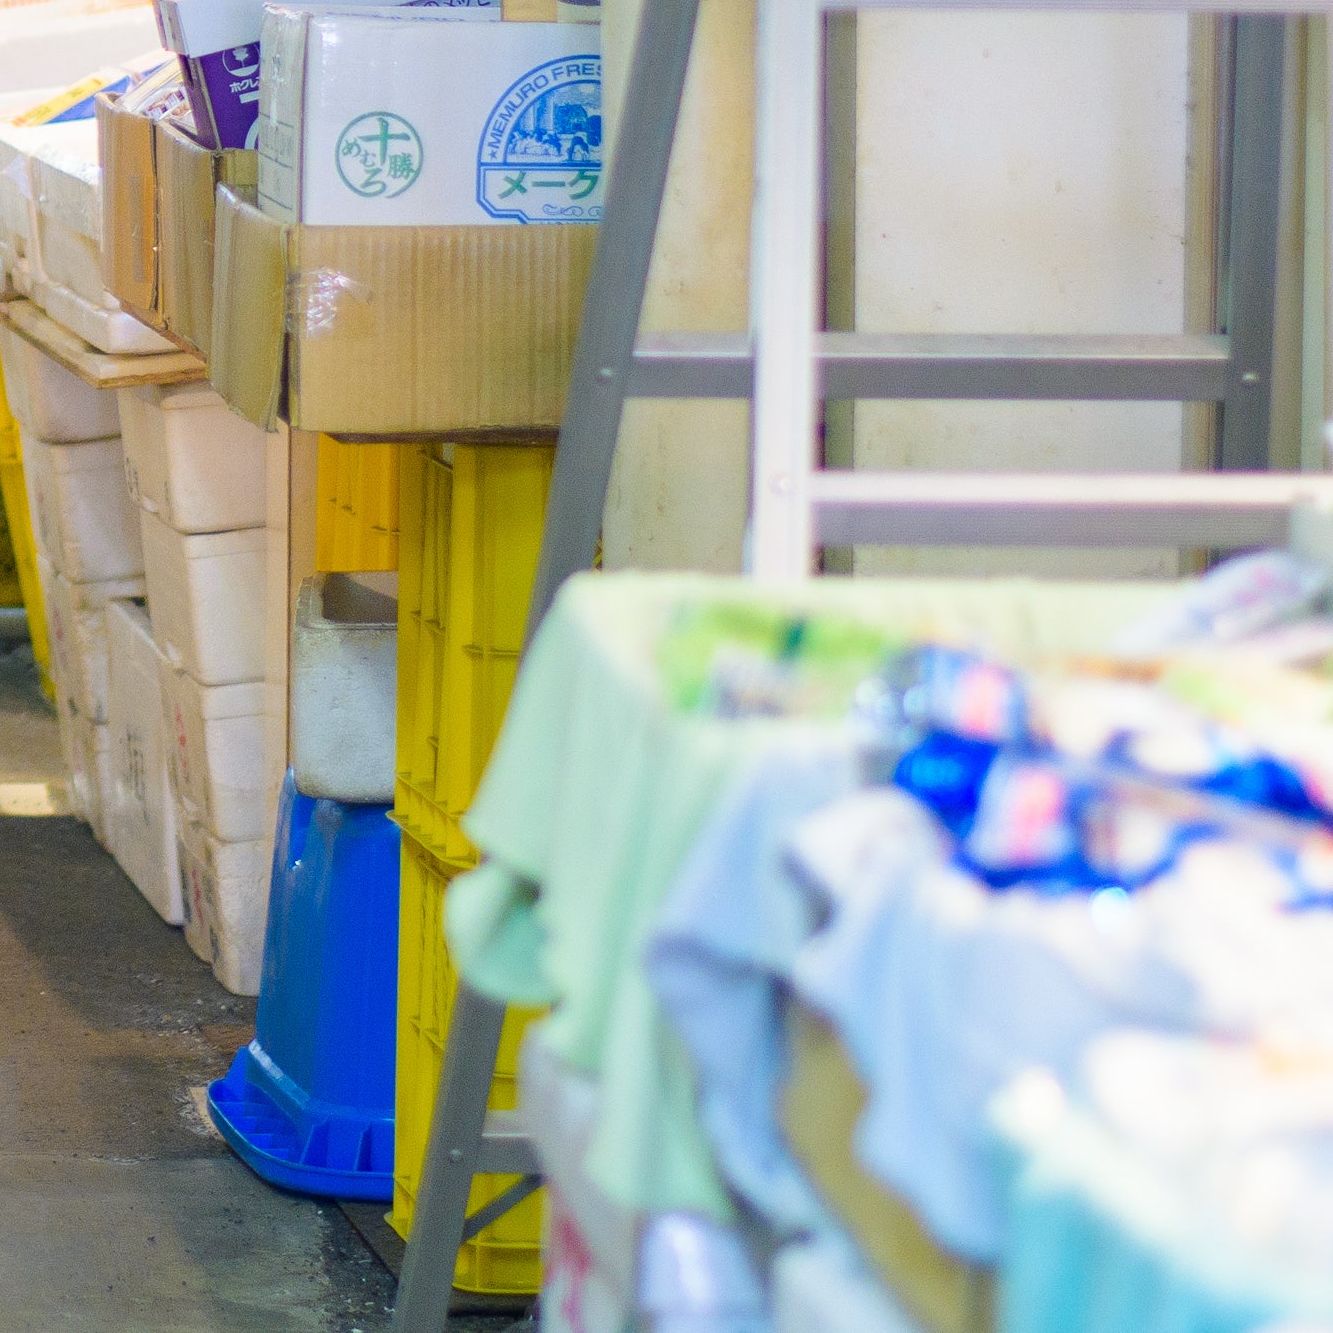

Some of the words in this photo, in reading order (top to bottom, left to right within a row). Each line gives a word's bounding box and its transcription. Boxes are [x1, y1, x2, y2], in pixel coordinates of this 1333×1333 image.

[487, 74, 550, 150] MEMURO
[496, 169, 600, 201] メーク
